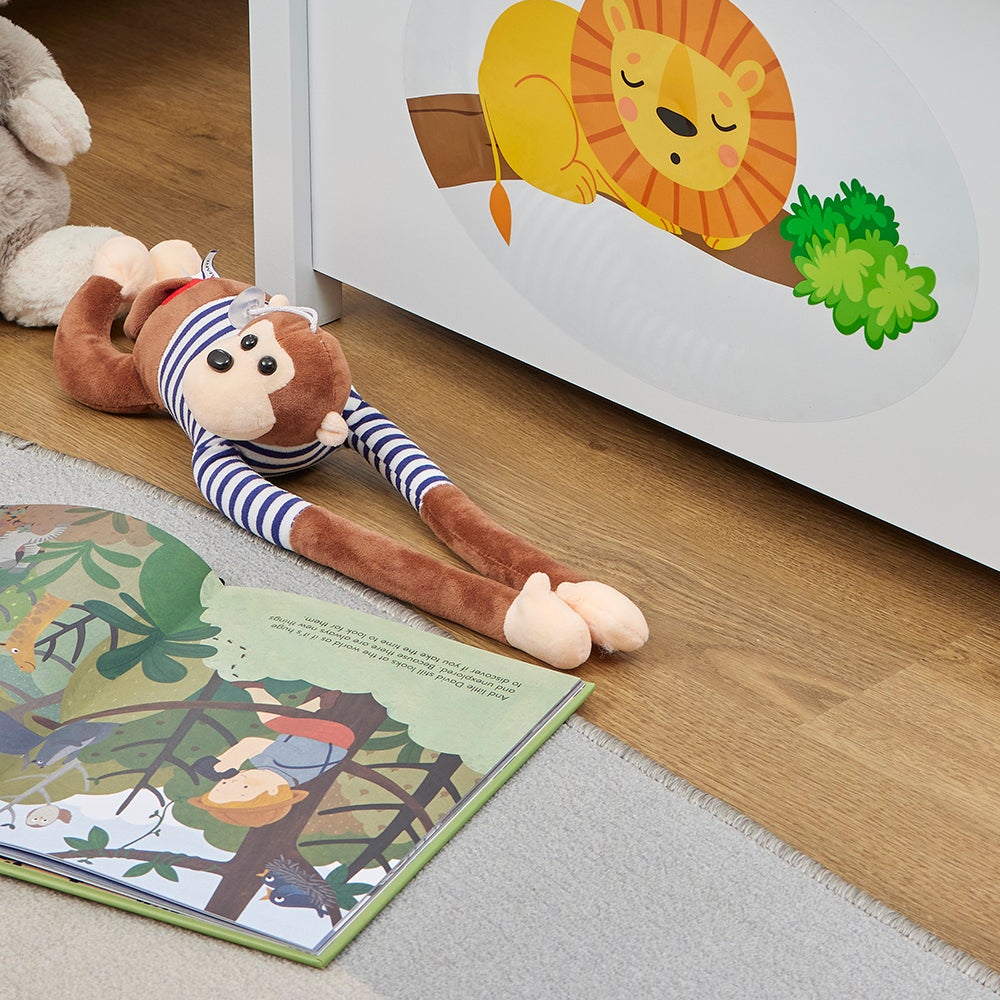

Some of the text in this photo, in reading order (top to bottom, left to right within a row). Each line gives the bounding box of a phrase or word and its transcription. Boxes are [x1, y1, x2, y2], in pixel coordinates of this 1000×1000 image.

[304, 615, 329, 627] them.
[270, 623, 295, 634] huge
[330, 624, 344, 633] for
[345, 628, 367, 639] look
[296, 630, 311, 639] it's
[332, 640, 360, 652] world
[380, 640, 400, 650] time
[268, 615, 516, 694] and unexplored. Because there are always new things
[362, 650, 376, 659] the
[402, 646, 418, 656] the
[419, 652, 441, 663] take
[391, 659, 416, 673] looks
[442, 660, 461, 668] you
[416, 667, 435, 676] still
[470, 668, 510, 685] discover
[435, 674, 465, 688] David
[467, 683, 487, 696] little
[487, 691, 510, 701] And
